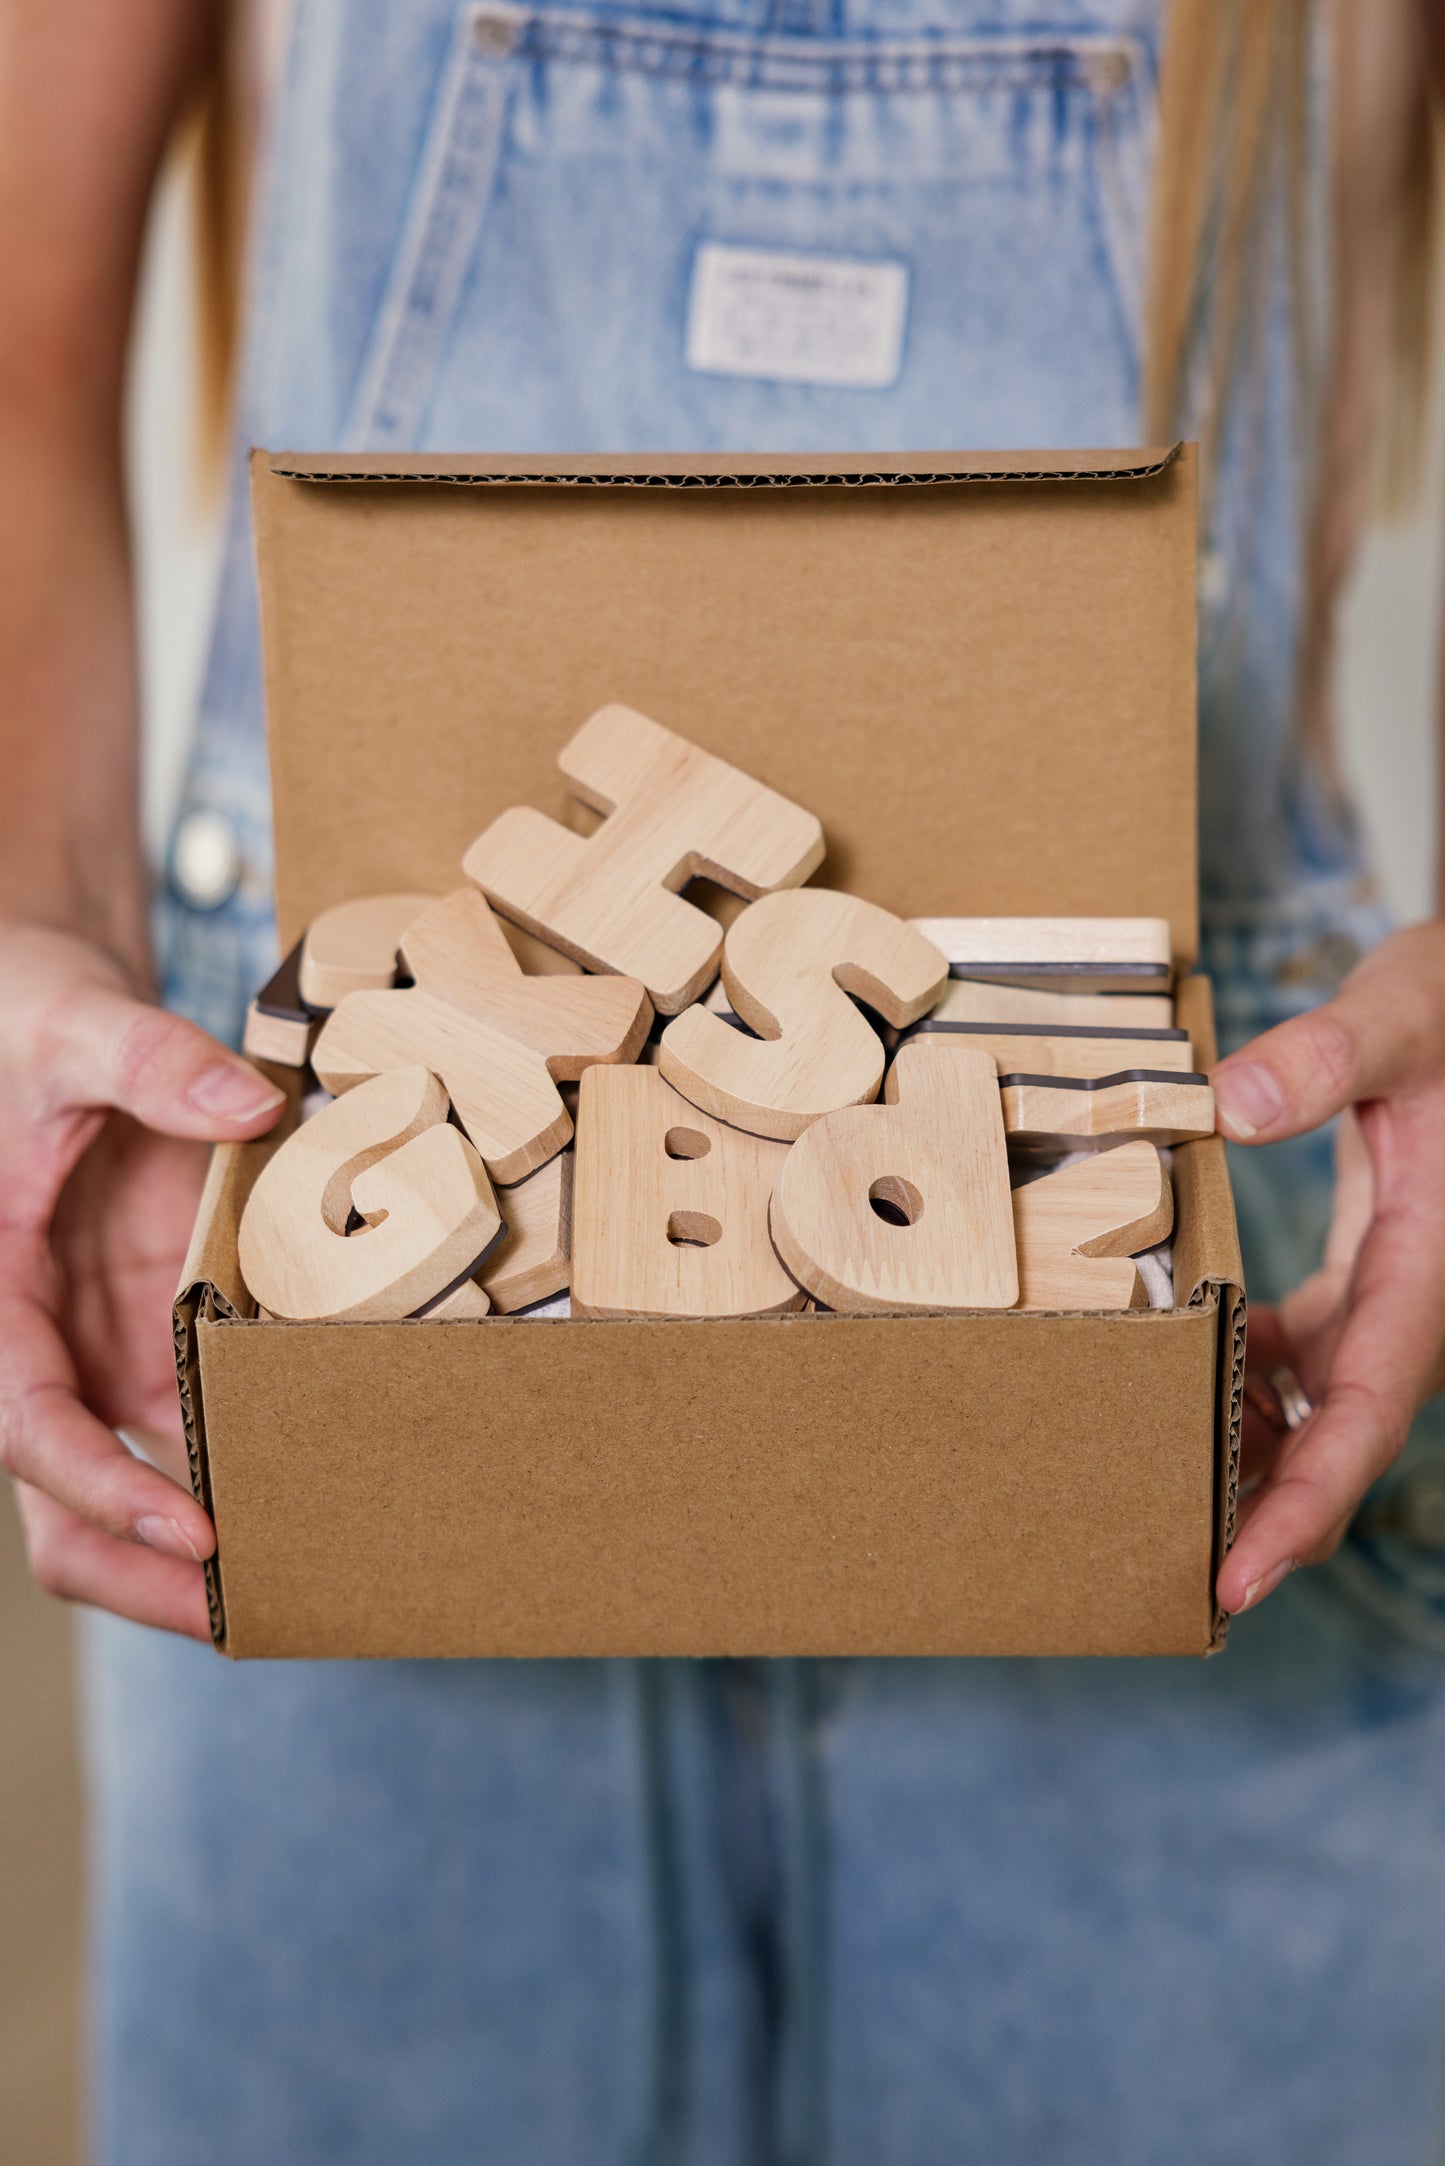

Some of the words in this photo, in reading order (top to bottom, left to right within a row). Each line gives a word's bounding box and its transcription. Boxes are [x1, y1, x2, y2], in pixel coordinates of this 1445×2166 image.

[463, 703, 825, 1013] H
[311, 888, 655, 1186] X
[659, 888, 949, 1141] S
[238, 1065, 503, 1320] G
[571, 1063, 808, 1319] B
